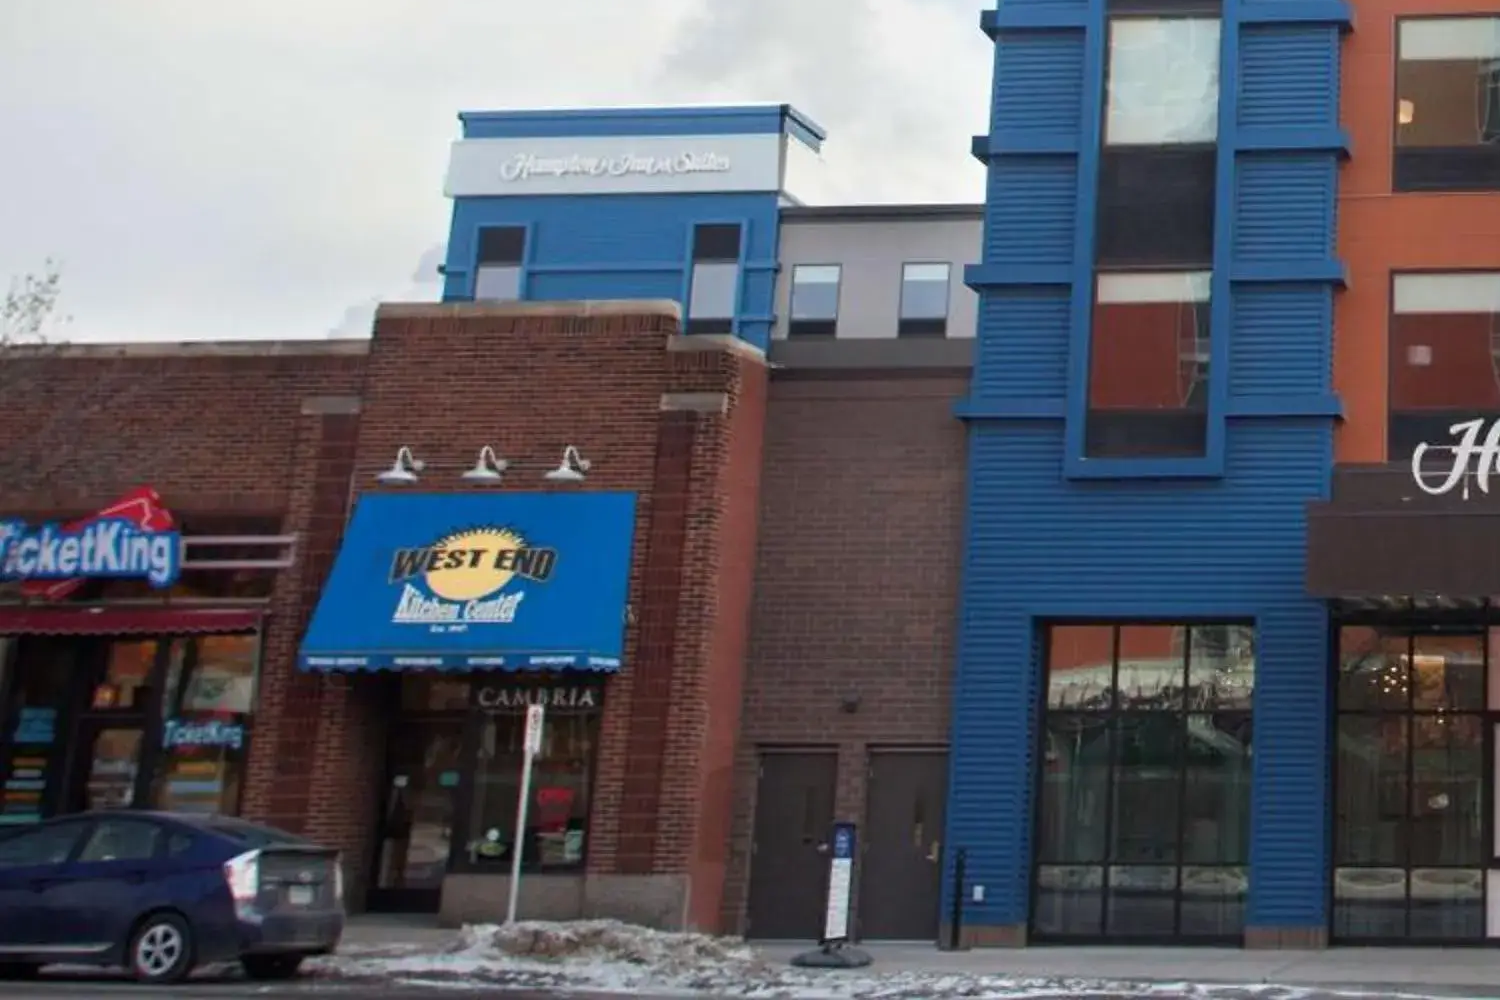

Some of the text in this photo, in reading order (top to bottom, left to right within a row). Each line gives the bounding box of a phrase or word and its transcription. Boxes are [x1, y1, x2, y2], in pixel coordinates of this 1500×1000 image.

[390, 547, 557, 583] WEST END
[477, 686, 596, 708] CAMBRIA
